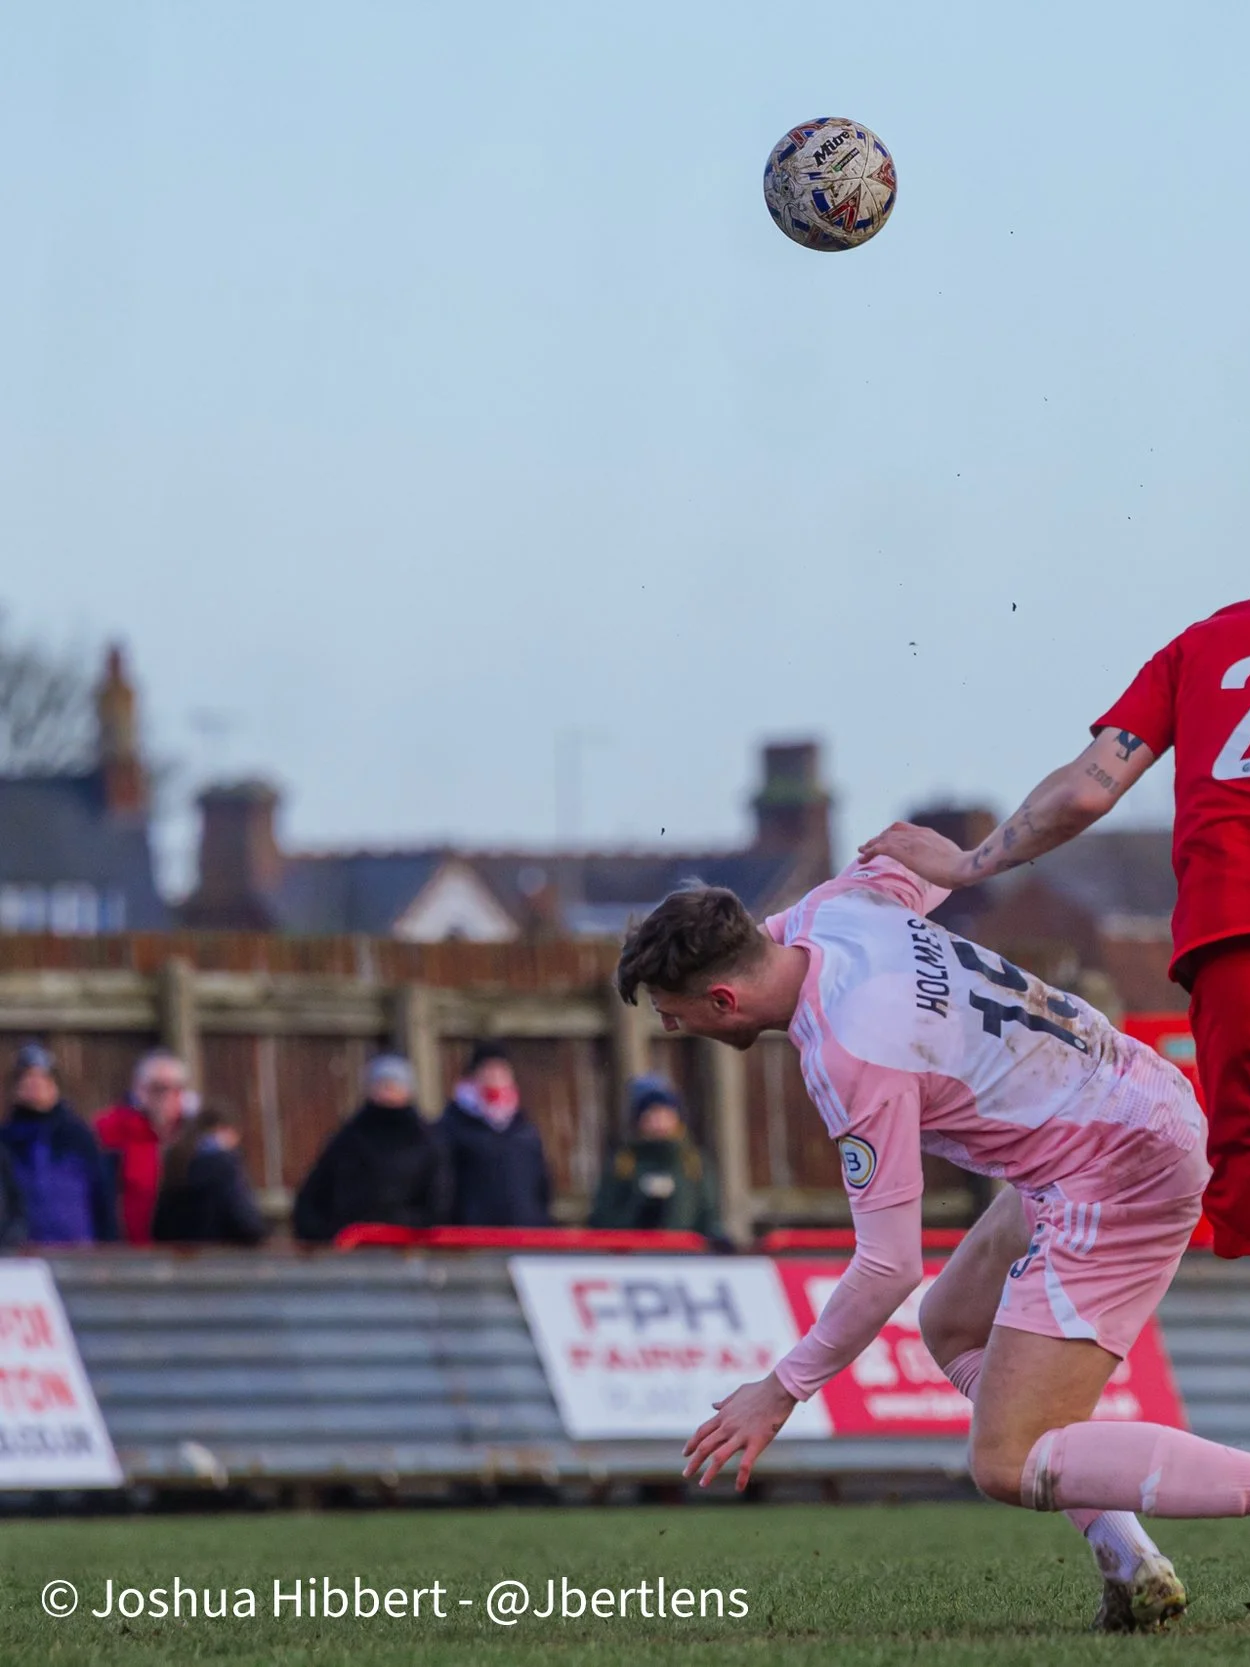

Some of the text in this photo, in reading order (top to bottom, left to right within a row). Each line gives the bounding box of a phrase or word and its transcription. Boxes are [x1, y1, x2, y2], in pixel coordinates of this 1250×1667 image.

[813, 130, 850, 167] Mitre
[907, 919, 948, 1018] HOLMES
[571, 1275, 745, 1334] FPH
